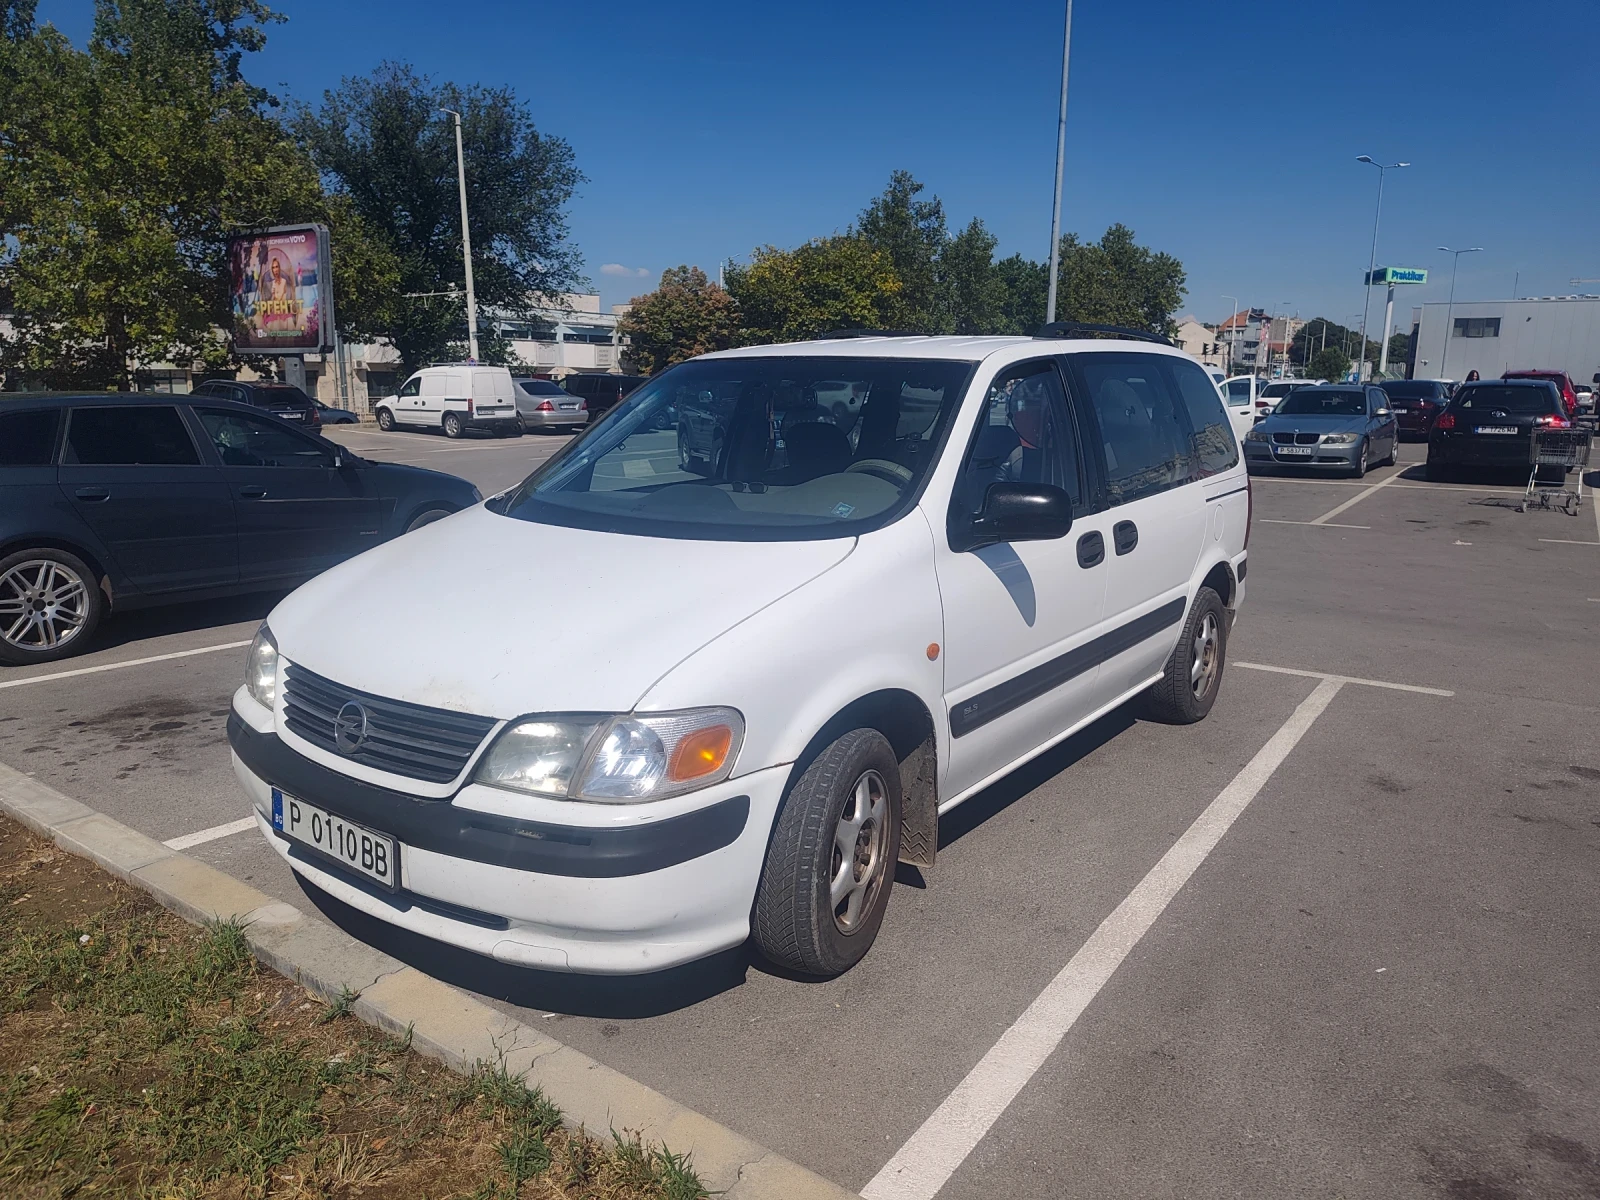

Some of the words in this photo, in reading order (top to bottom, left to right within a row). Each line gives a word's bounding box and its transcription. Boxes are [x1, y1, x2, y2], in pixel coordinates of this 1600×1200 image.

[289, 235, 306, 243] VOYO
[1391, 269, 1425, 281] Praktiker
[275, 813, 283, 825] BG
[289, 801, 301, 832] P
